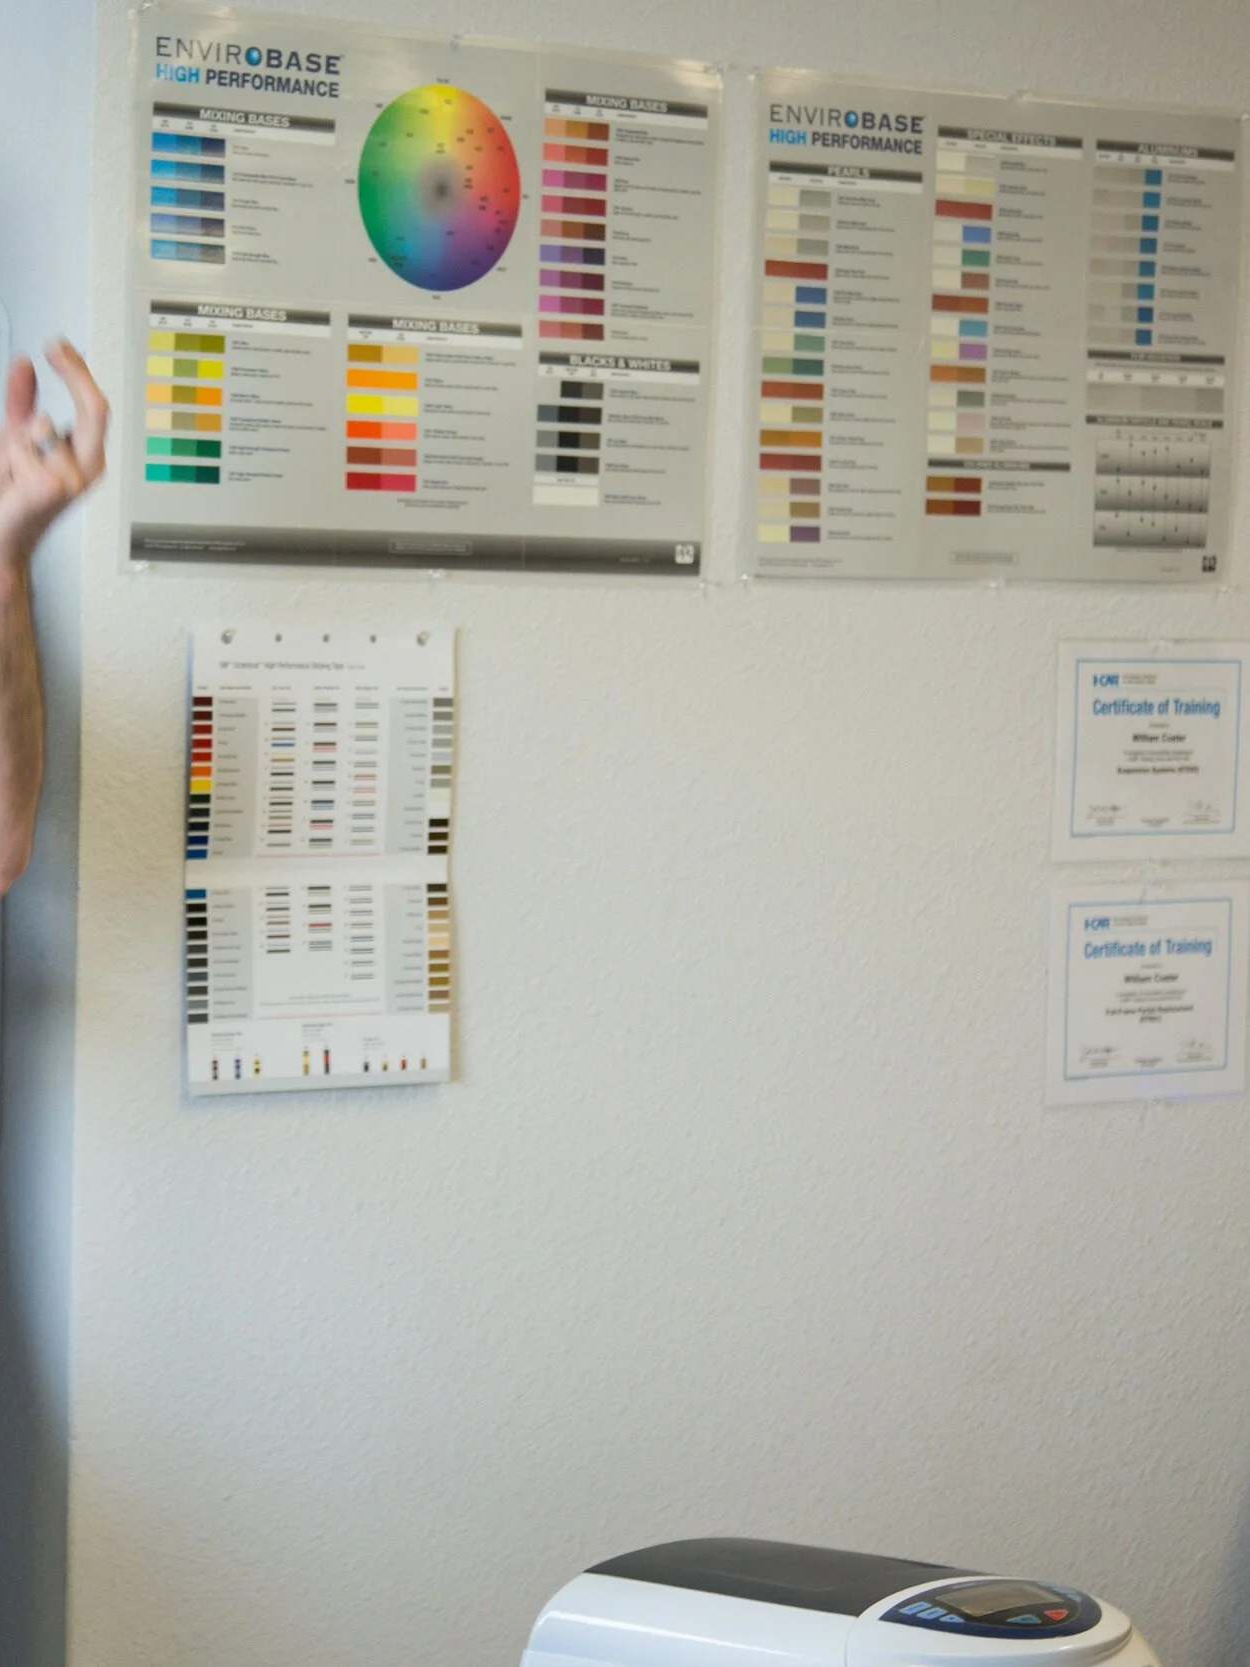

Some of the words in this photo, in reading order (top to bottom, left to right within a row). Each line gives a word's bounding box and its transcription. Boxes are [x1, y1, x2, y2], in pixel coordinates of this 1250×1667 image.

[155, 36, 341, 76] ENVIROBASE
[155, 63, 200, 84] HIGH
[205, 69, 340, 98] PERFORMANCE
[586, 95, 628, 109] MIXING
[630, 98, 668, 113] BASES
[199, 108, 246, 123] MIXING
[248, 113, 290, 128] BASES
[769, 104, 924, 134] ENVIROBASE
[769, 128, 807, 145] HIGH
[811, 131, 923, 155] PERFORMANCE
[198, 305, 243, 319] MIXING
[246, 308, 287, 322] BASES
[392, 319, 437, 332] MIXING
[439, 321, 480, 334] BASES
[569, 354, 615, 368] BLACKS
[617, 356, 626, 368] &
[628, 358, 671, 371] WHITES
[1092, 697, 1155, 716] Certificate
[1158, 698, 1170, 716] of
[1173, 698, 1221, 719] Training
[1084, 940, 1146, 959] Certificate
[1148, 939, 1162, 956] of
[1165, 938, 1213, 957] Training
